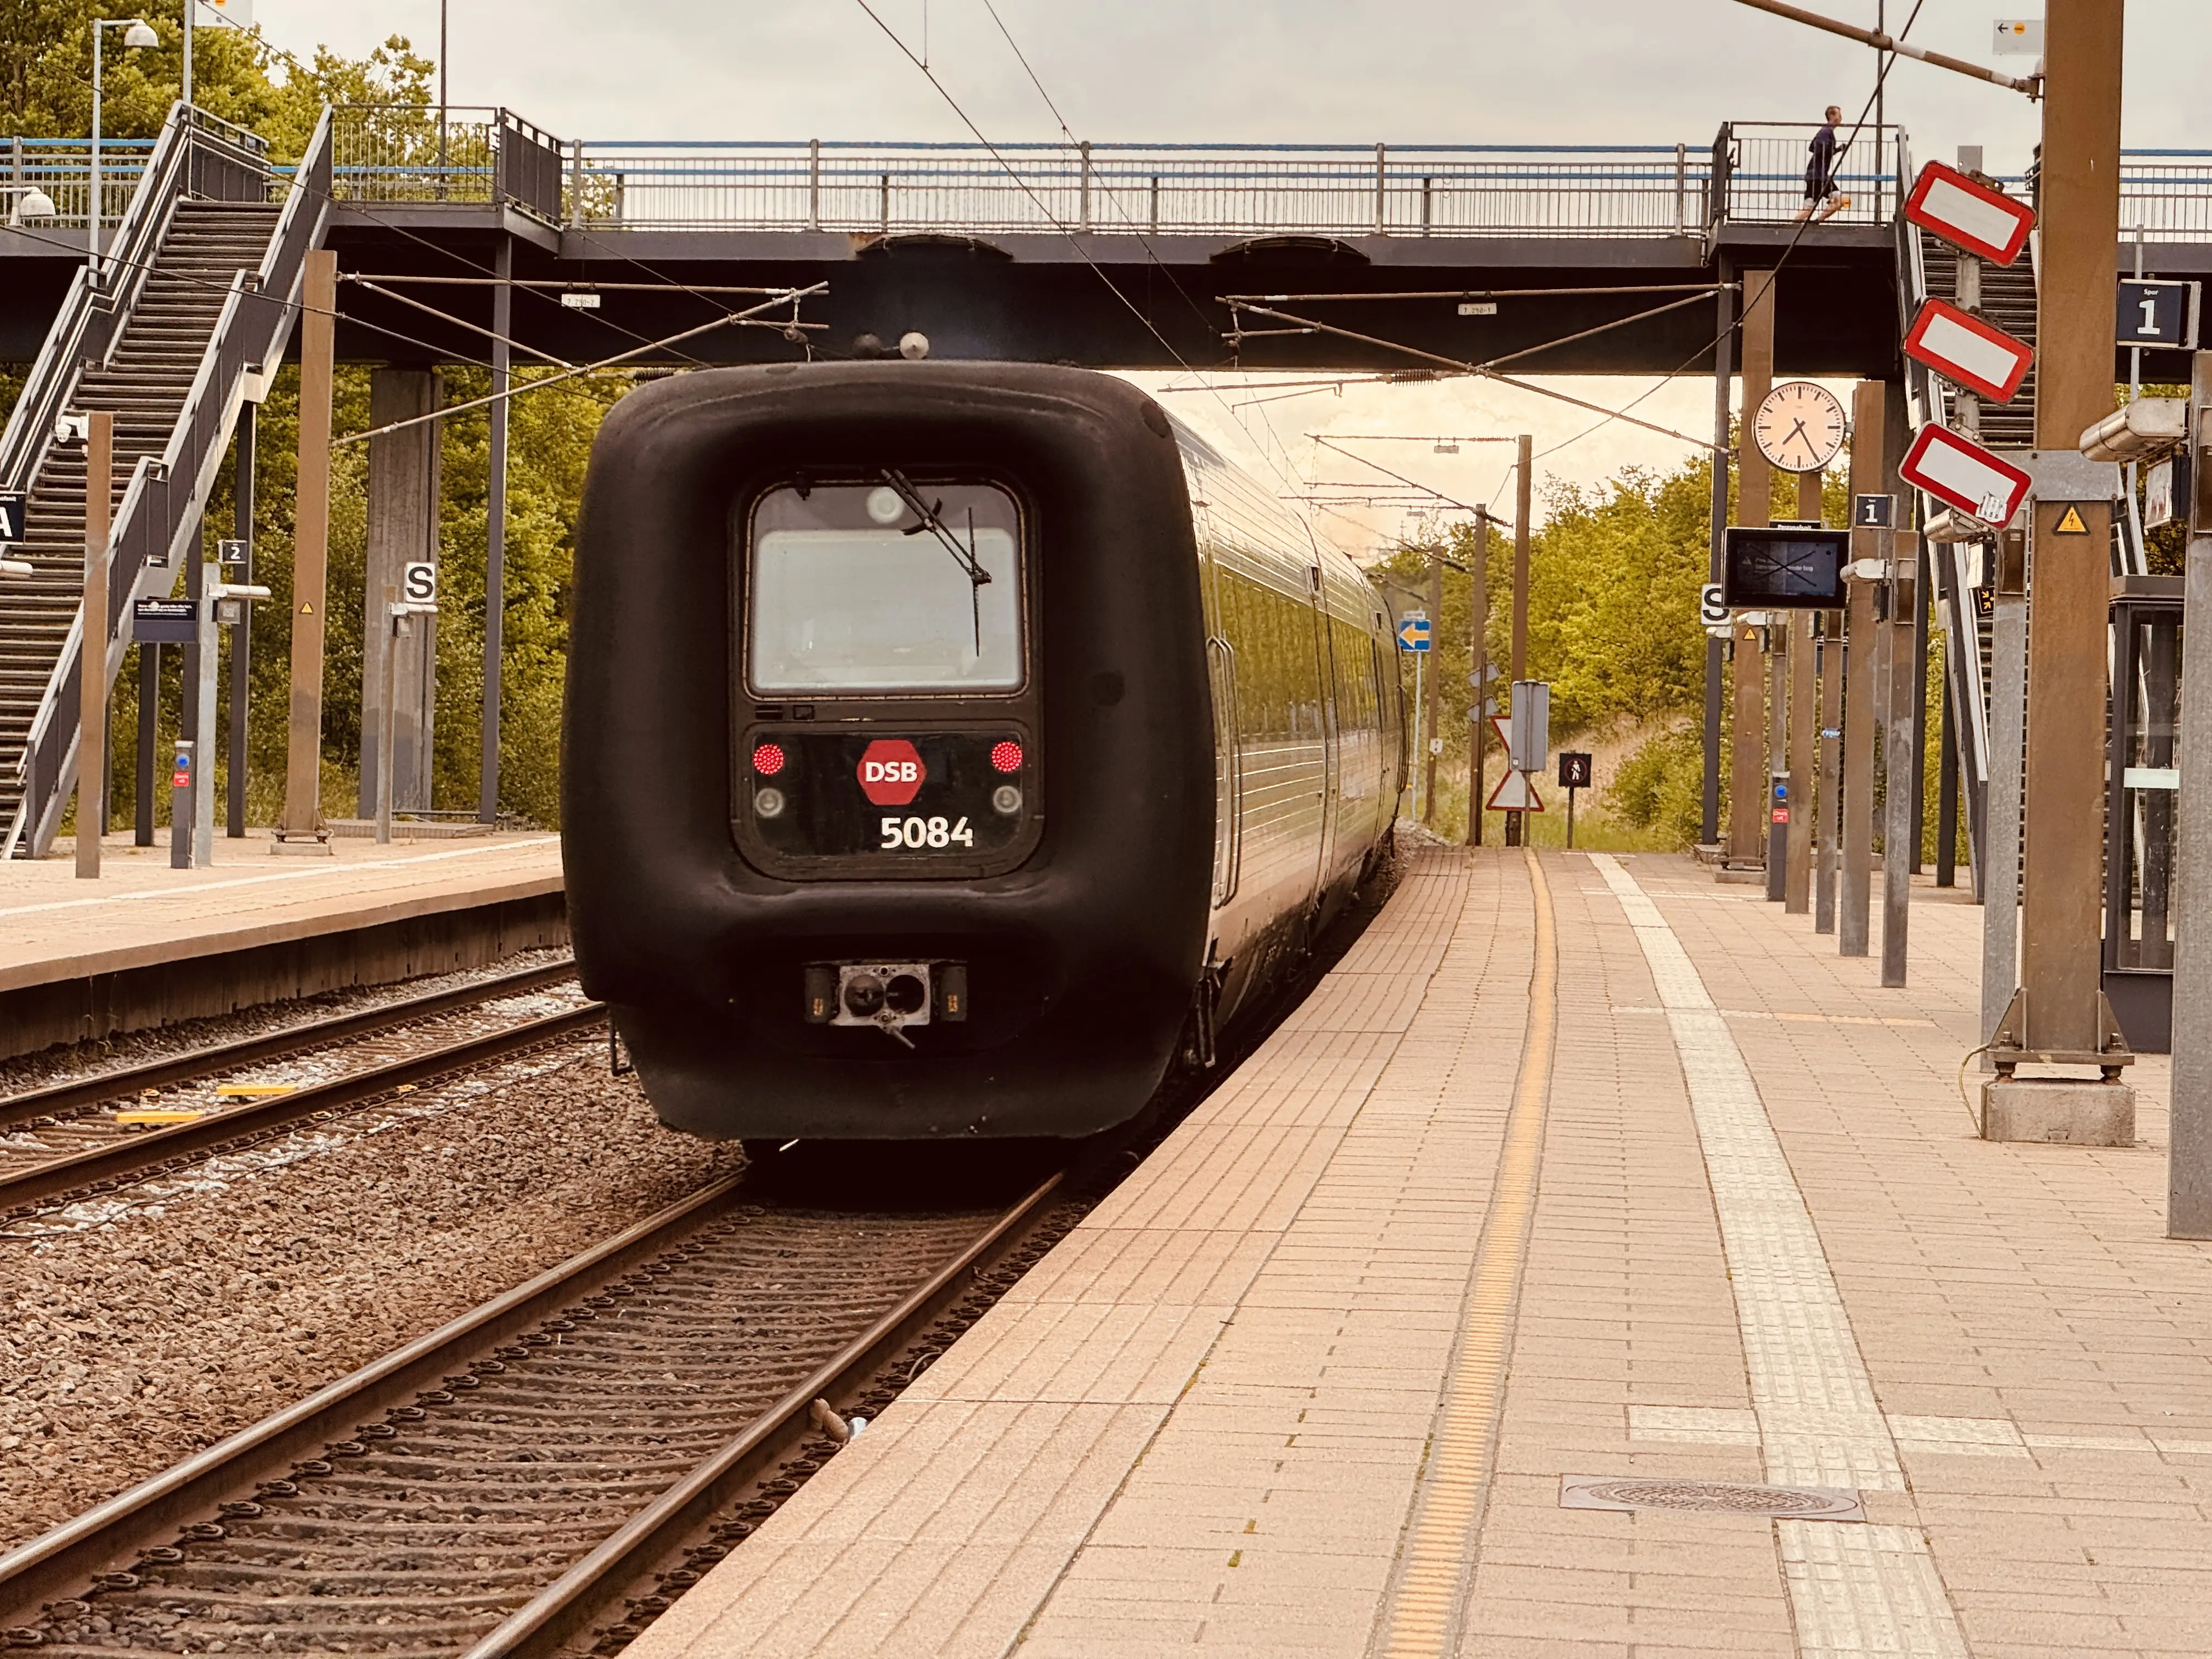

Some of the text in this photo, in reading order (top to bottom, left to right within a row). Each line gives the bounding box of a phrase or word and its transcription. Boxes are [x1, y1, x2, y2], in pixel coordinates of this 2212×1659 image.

[2137, 300, 2160, 335] 1
[1865, 504, 1878, 523] 1
[230, 546, 240, 560] 2
[406, 566, 433, 599] S
[1702, 588, 1730, 622] S
[866, 761, 917, 782] DSB
[881, 816, 973, 849] 5084
